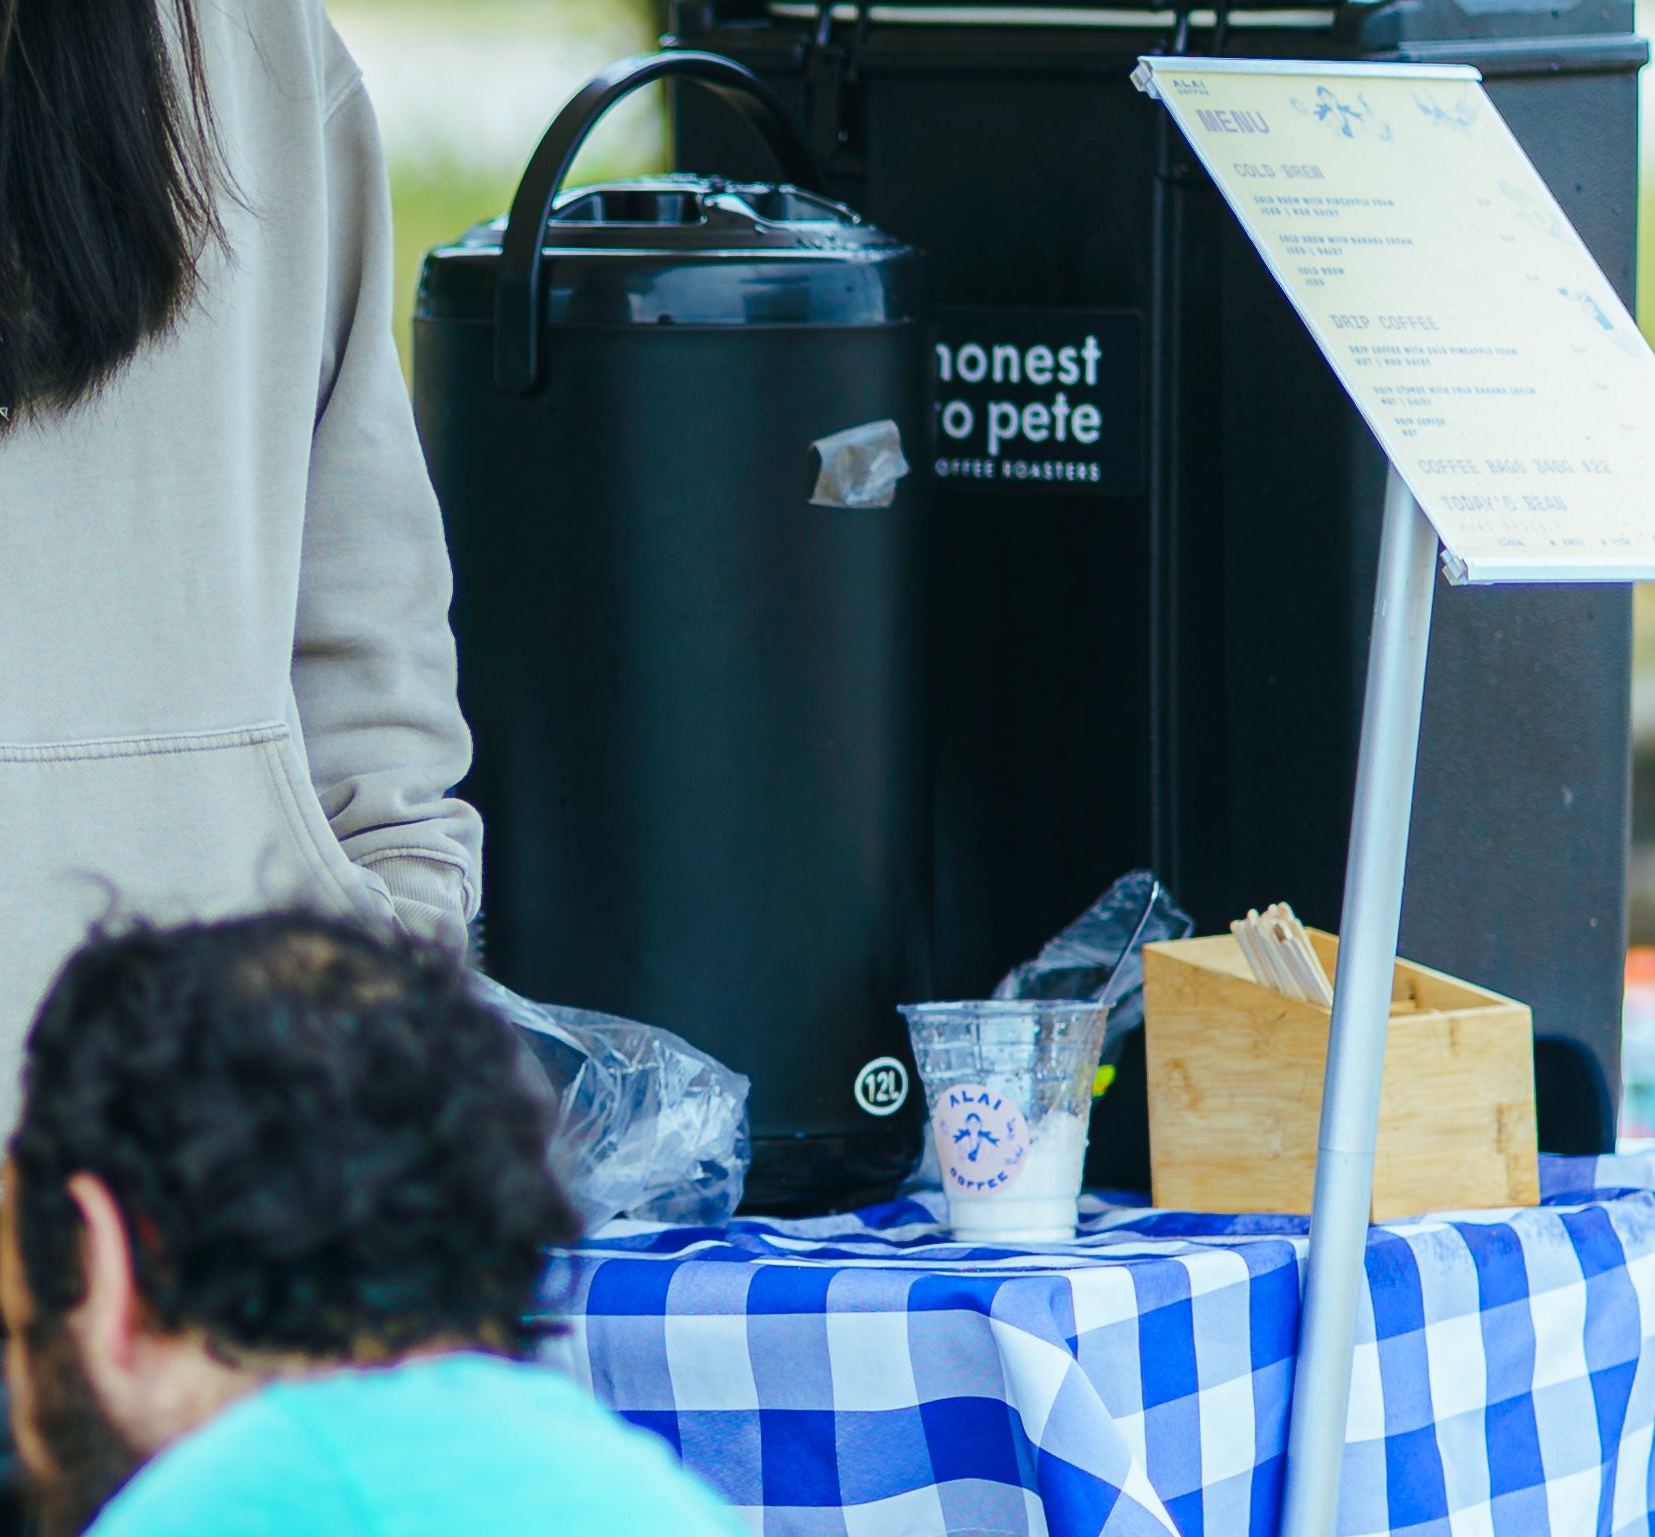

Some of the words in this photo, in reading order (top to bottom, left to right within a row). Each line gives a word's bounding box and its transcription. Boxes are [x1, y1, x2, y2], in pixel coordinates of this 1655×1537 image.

[1172, 79, 1206, 89] ALAI
[1195, 109, 1270, 134] MENU
[1233, 163, 1276, 178] COLD
[1281, 164, 1325, 179] BREW
[1253, 195, 1274, 205] COLD
[1302, 196, 1324, 206] WITH
[1330, 314, 1370, 330] DRIP
[1378, 315, 1440, 331] COFFEE
[934, 400, 974, 440] o
[987, 391, 1103, 457] pete
[935, 457, 994, 479] OFFEE
[1002, 459, 1101, 482] ROASTERS
[1418, 459, 1480, 475] COFFEE
[1521, 495, 1568, 512] BEAN
[865, 1069, 900, 1103] 12L
[949, 1090, 1002, 1111] ALAI
[950, 1167, 1008, 1191] COFFEE
